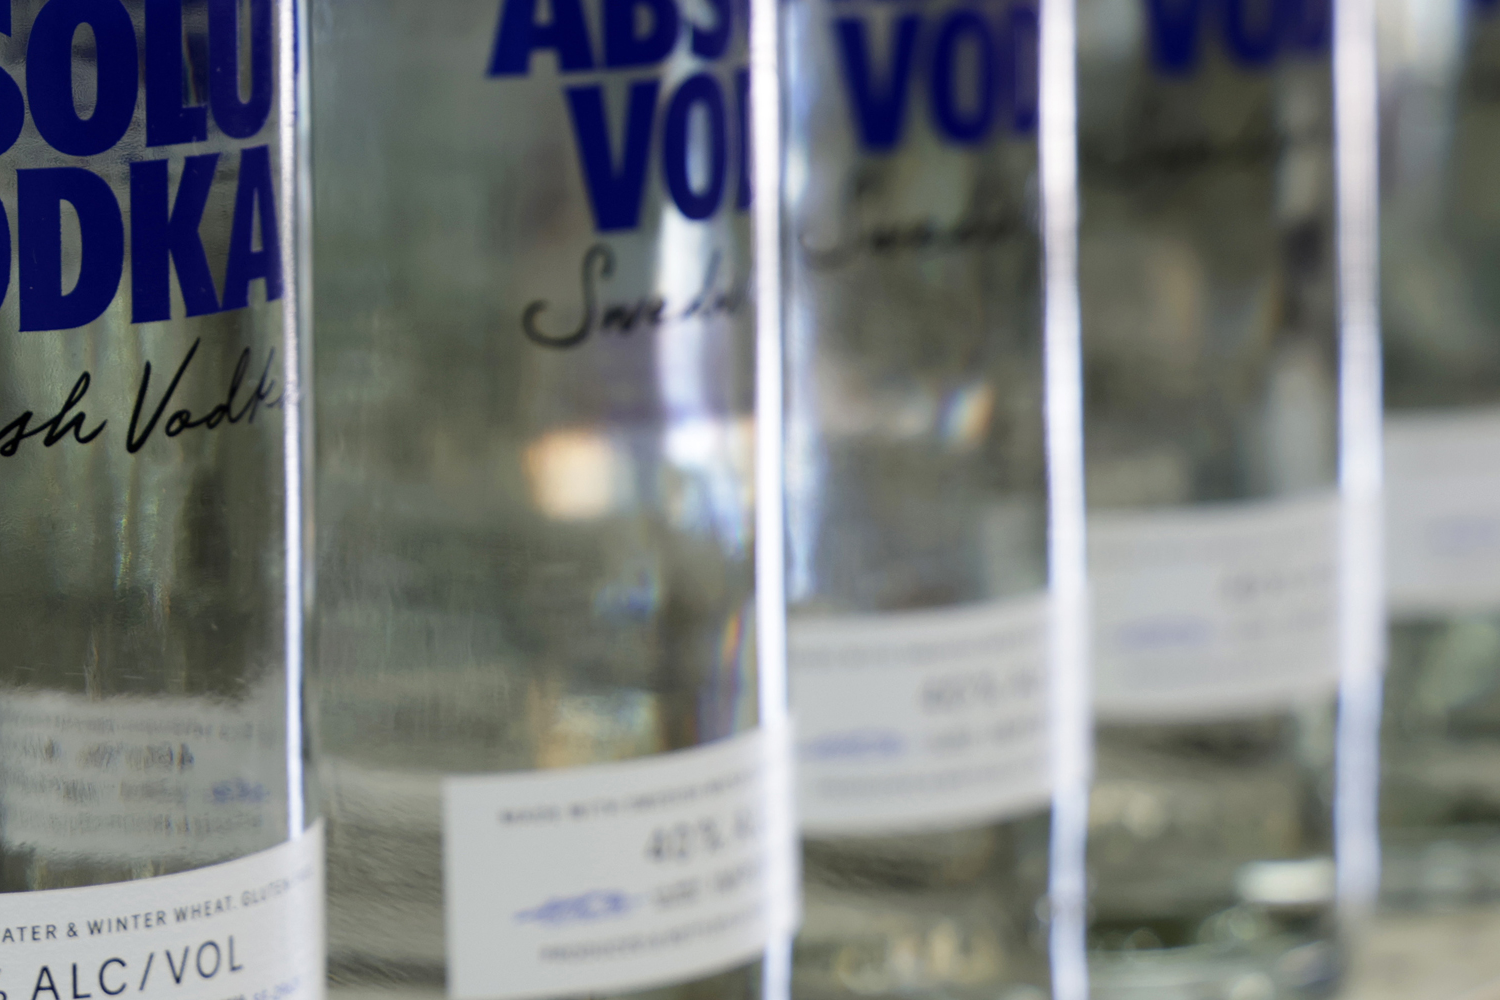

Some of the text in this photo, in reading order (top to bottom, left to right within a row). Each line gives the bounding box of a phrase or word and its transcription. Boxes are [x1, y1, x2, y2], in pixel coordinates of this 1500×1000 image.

[564, 66, 750, 234] VO
[67, 922, 78, 938] &
[87, 910, 168, 936] WINTER
[30, 935, 244, 1000] ALC/VOL
